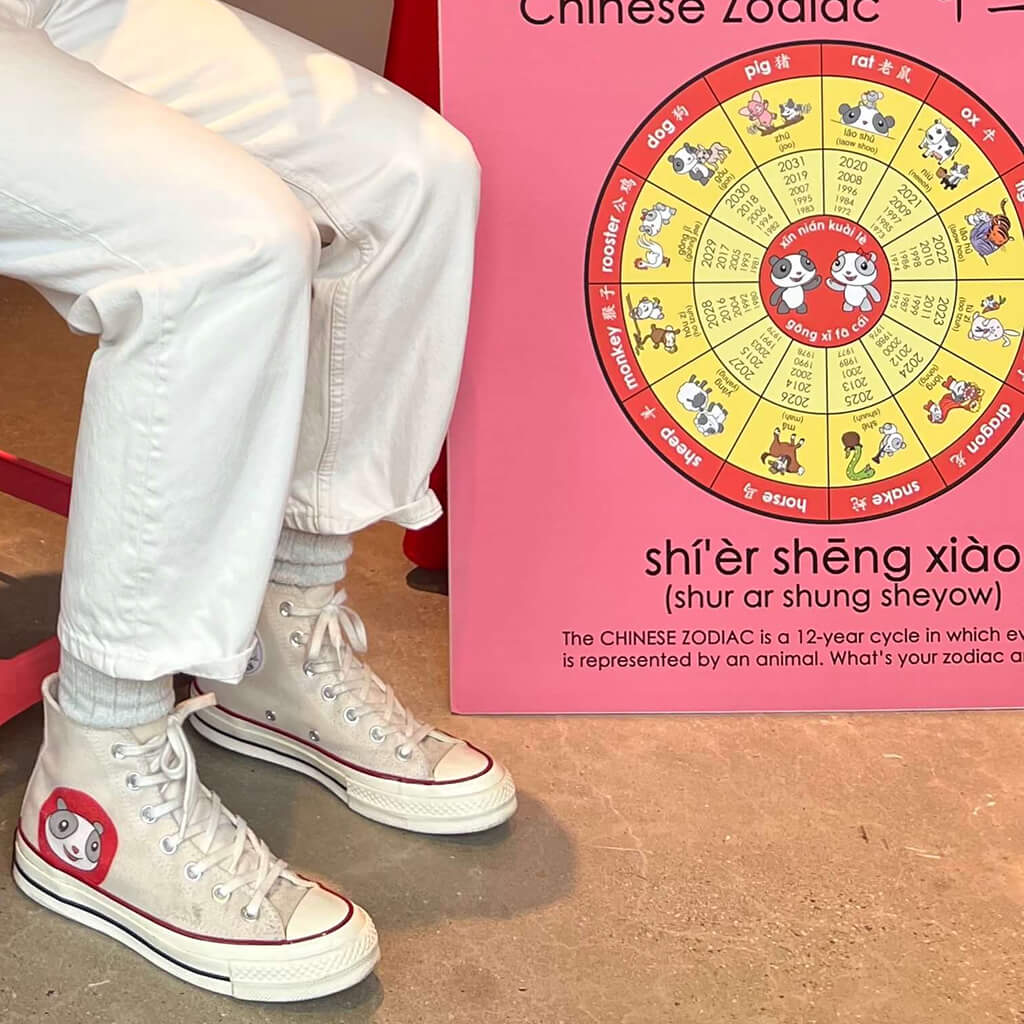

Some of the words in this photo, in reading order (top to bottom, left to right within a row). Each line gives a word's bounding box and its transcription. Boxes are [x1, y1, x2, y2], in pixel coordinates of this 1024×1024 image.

[744, 59, 772, 80] pig
[851, 54, 875, 70] rat
[960, 107, 981, 127] ox
[647, 118, 676, 150] dog
[778, 155, 806, 173] 2031
[839, 155, 868, 173] 2020
[725, 183, 751, 209] 2030
[897, 183, 923, 209] 2021
[601, 215, 621, 273] rooster
[701, 238, 717, 268] 2029
[932, 234, 949, 265] 2022
[701, 299, 719, 329] 2028
[933, 297, 950, 327] 2023
[607, 325, 640, 391] monkey
[728, 357, 755, 382] 2027
[899, 352, 924, 379] 2024
[781, 391, 810, 409] 2026
[844, 389, 874, 406] 2025
[966, 403, 1012, 454] dragon
[660, 427, 703, 468] sheep
[762, 489, 807, 513] horse
[872, 480, 921, 506] snake
[773, 538, 911, 582] shēng
[926, 535, 1022, 575] xiào
[664, 583, 735, 615] (shur
[743, 587, 775, 609] ar
[782, 583, 871, 614] shung
[880, 581, 1003, 612] sheyow)
[562, 631, 594, 646] The
[600, 630, 676, 646] CHINESE
[682, 629, 754, 645] ZODIAC
[760, 629, 772, 645] is
[777, 632, 789, 644] a
[797, 629, 864, 647] 12-year
[870, 627, 920, 646] cycle
[925, 627, 941, 643] in
[946, 626, 1001, 643] which
[562, 652, 574, 667] is
[580, 651, 691, 671] represented
[698, 651, 720, 670] by
[726, 653, 750, 667] an
[756, 651, 824, 666] animal.
[829, 649, 893, 666] What's
[898, 652, 938, 668] your
[942, 648, 1004, 664] zodiac
